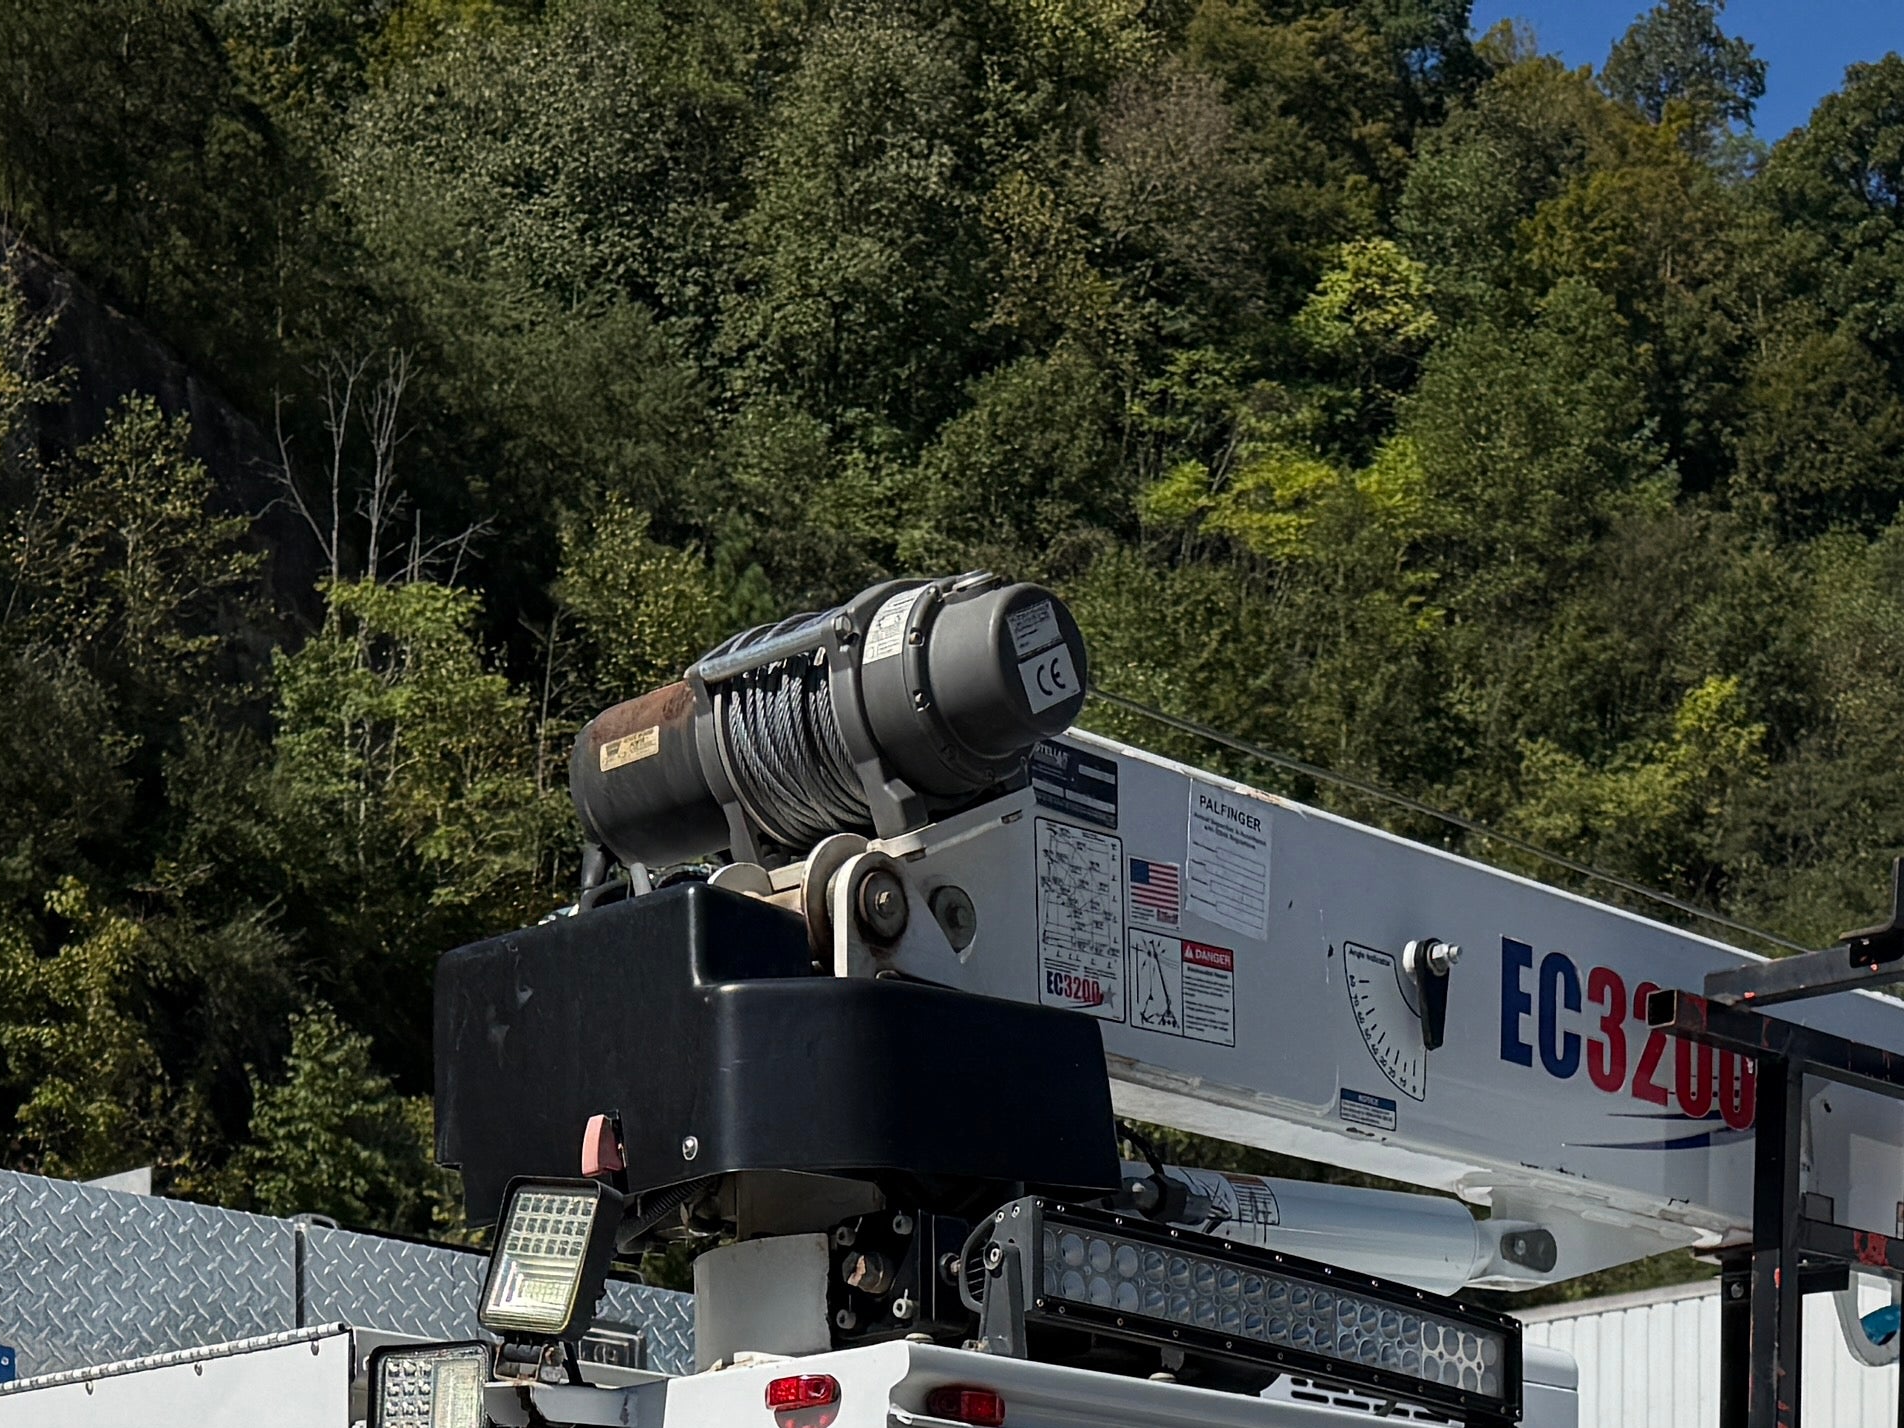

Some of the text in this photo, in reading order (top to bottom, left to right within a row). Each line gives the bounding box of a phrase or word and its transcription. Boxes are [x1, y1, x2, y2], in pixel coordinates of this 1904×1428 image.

[1199, 794, 1261, 833] PALFINGER
[1195, 948, 1231, 967] DANGER
[1046, 969, 1100, 1003] EC3200
[1500, 934, 1756, 1130] EC3200
